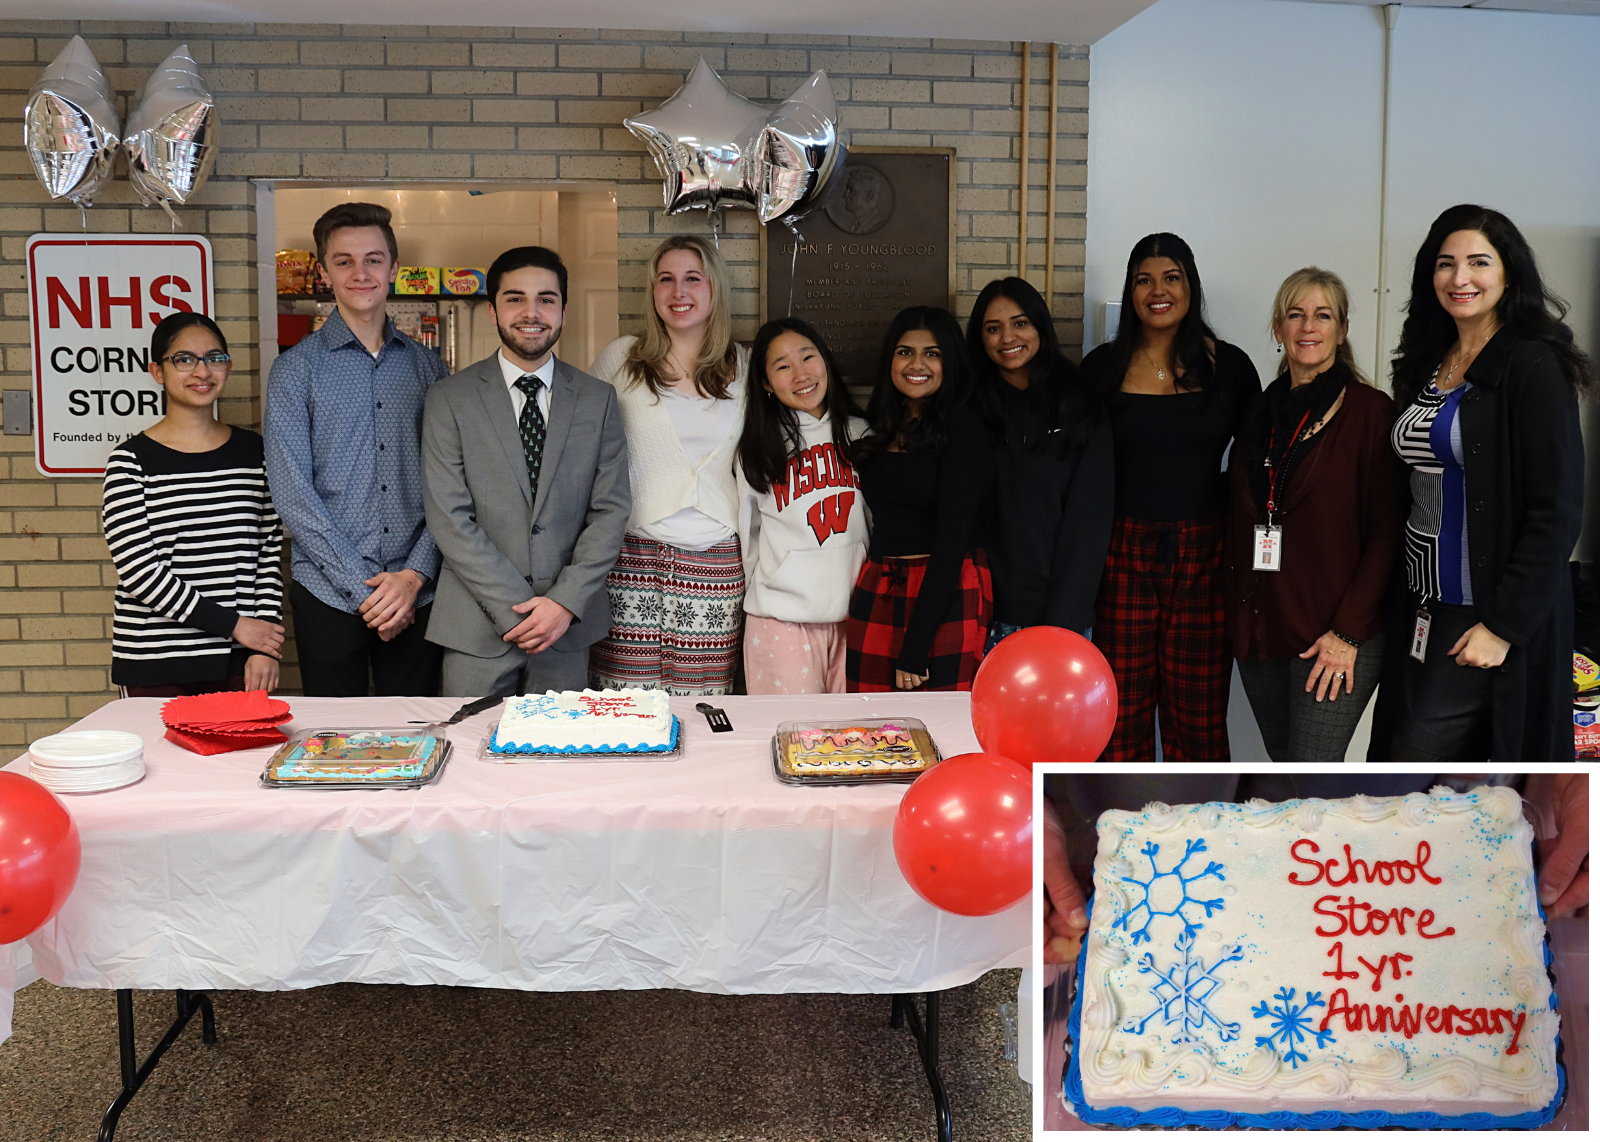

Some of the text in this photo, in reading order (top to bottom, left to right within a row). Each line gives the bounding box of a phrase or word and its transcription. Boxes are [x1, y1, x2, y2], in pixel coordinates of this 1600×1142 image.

[780, 244, 937, 256] JOHN F. YOUNGBLOOD
[829, 262, 851, 271] 1915
[866, 262, 889, 271] 1962
[448, 277, 477, 288] Swedish
[805, 278, 840, 286] MEMBER
[866, 278, 911, 286] PRESIDENT
[455, 285, 472, 293] Fish
[807, 291, 838, 299] BOARD
[46, 275, 194, 329] NHS
[794, 303, 841, 311] NISKAYUNA
[68, 390, 167, 416] STOR
[53, 432, 103, 442] Founded
[107, 432, 121, 444] by
[806, 491, 856, 547] W
[1288, 839, 1442, 887] School
[1314, 895, 1455, 939] Store
[1322, 941, 1413, 992] 1 yr.
[1319, 987, 1526, 1055] Anniversary
